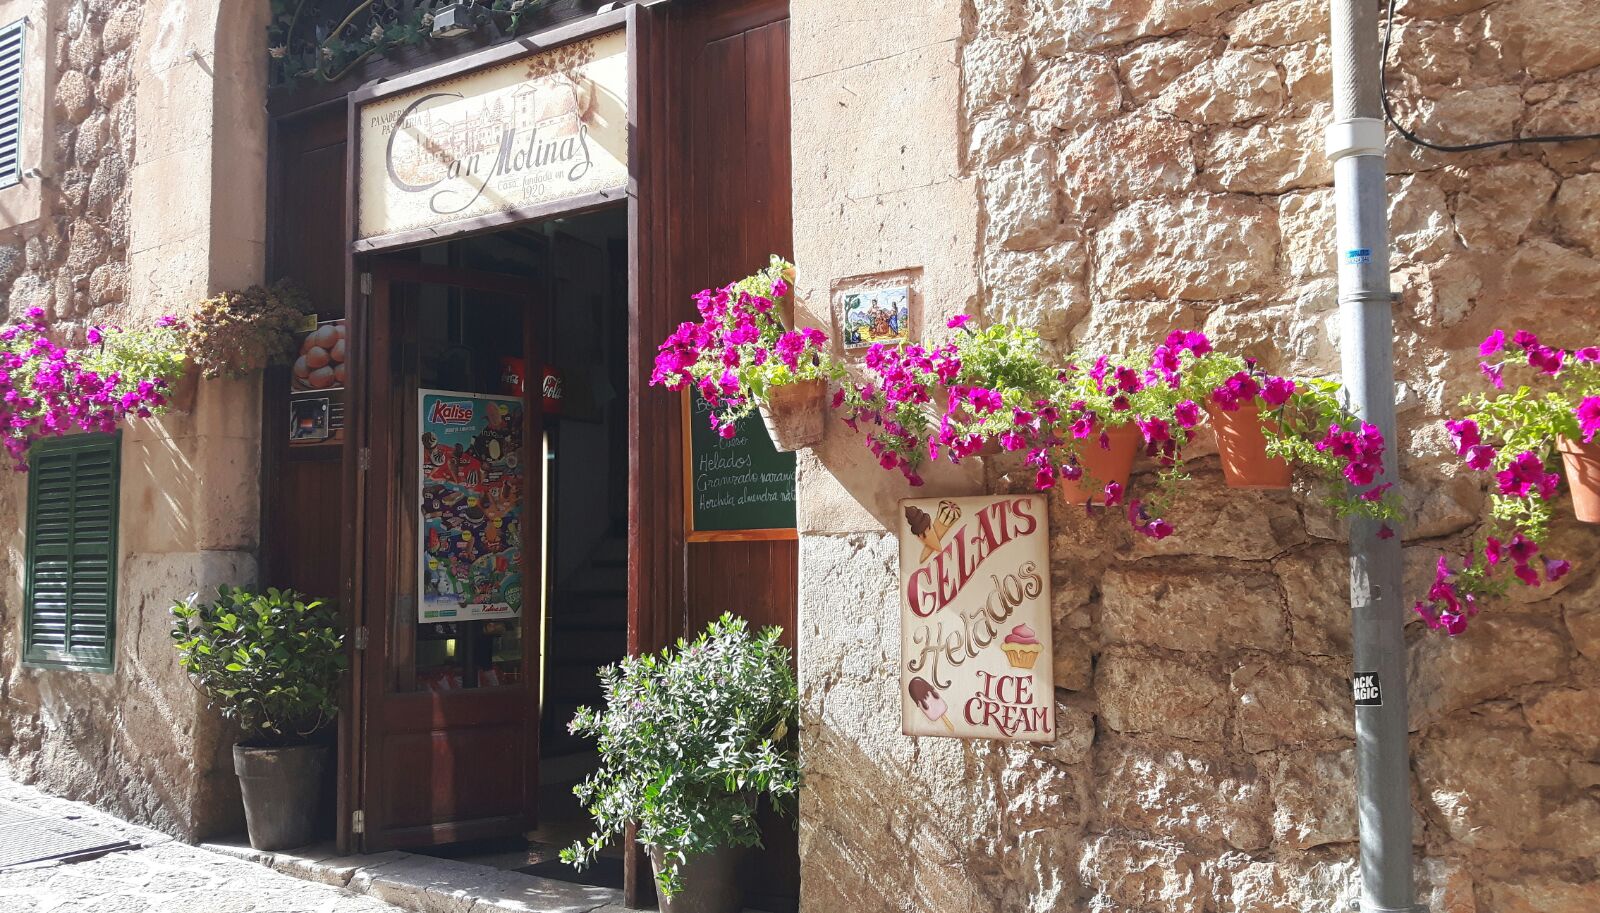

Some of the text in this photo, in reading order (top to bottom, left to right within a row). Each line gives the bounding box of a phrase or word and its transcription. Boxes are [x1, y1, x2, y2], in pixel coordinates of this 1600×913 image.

[381, 115, 422, 136] PASLERIA
[386, 93, 482, 193] Can
[522, 184, 545, 200] 1920
[542, 374, 562, 400] Cola
[431, 398, 474, 425] Kalise
[699, 451, 752, 472] Helados
[906, 497, 1038, 619] GELATS
[906, 560, 1044, 690] Helados
[975, 670, 1034, 706] ICE
[962, 697, 1052, 737] CREAM
